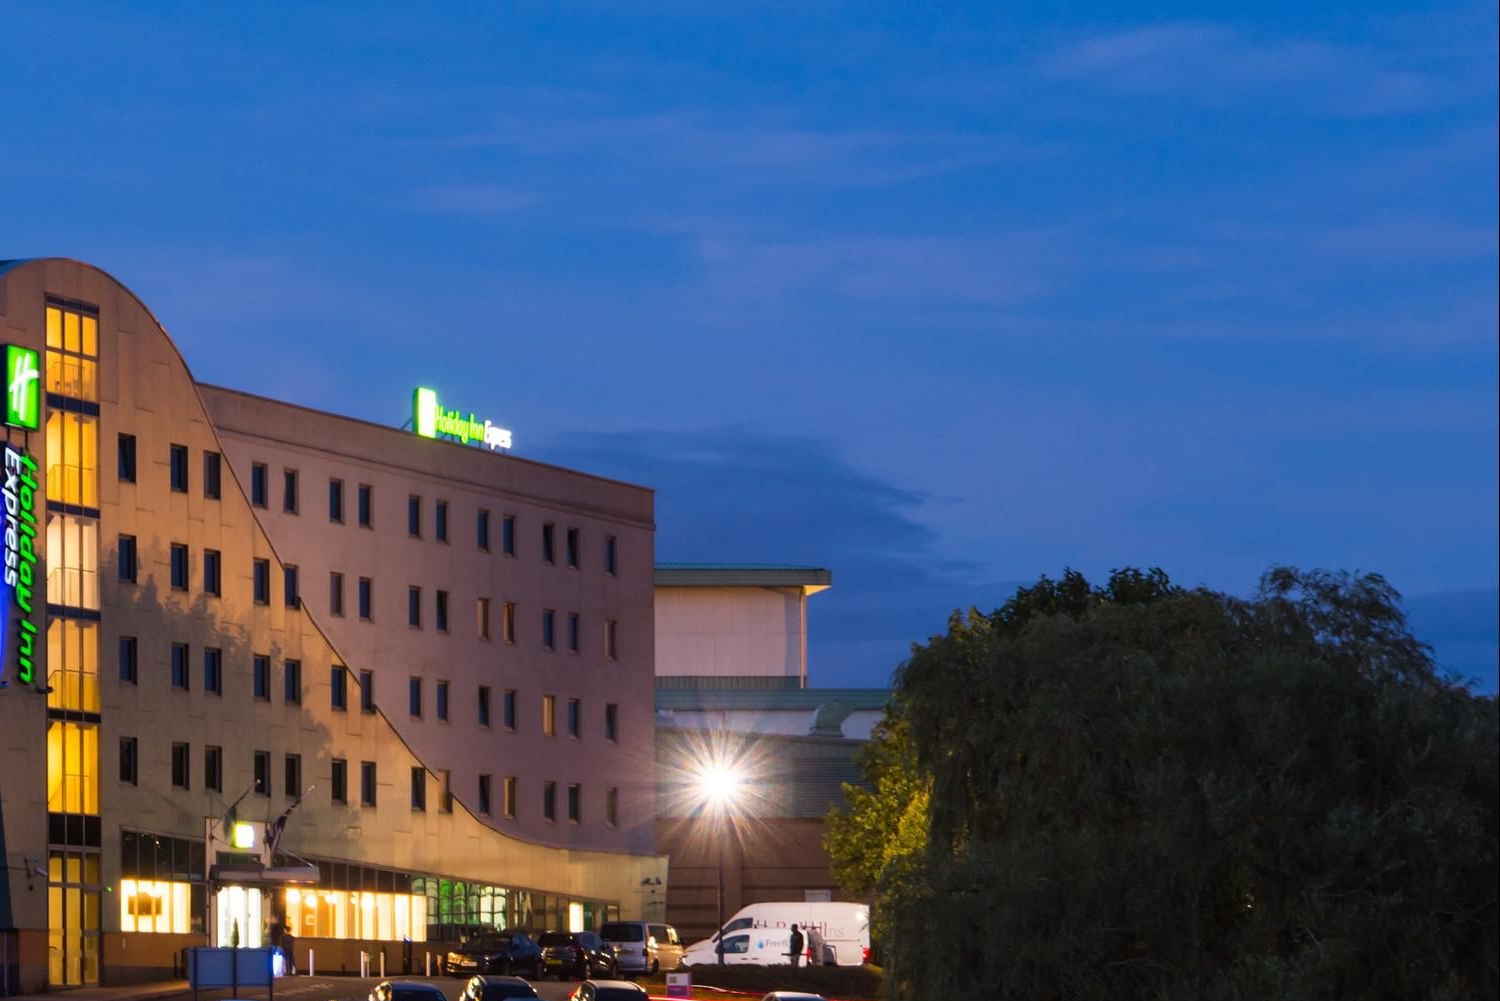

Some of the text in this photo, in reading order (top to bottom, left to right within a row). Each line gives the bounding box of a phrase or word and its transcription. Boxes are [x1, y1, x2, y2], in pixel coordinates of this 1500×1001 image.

[435, 405, 469, 444] Holiday
[2, 447, 21, 588] Express
[16, 451, 38, 684] Holiday Inn
